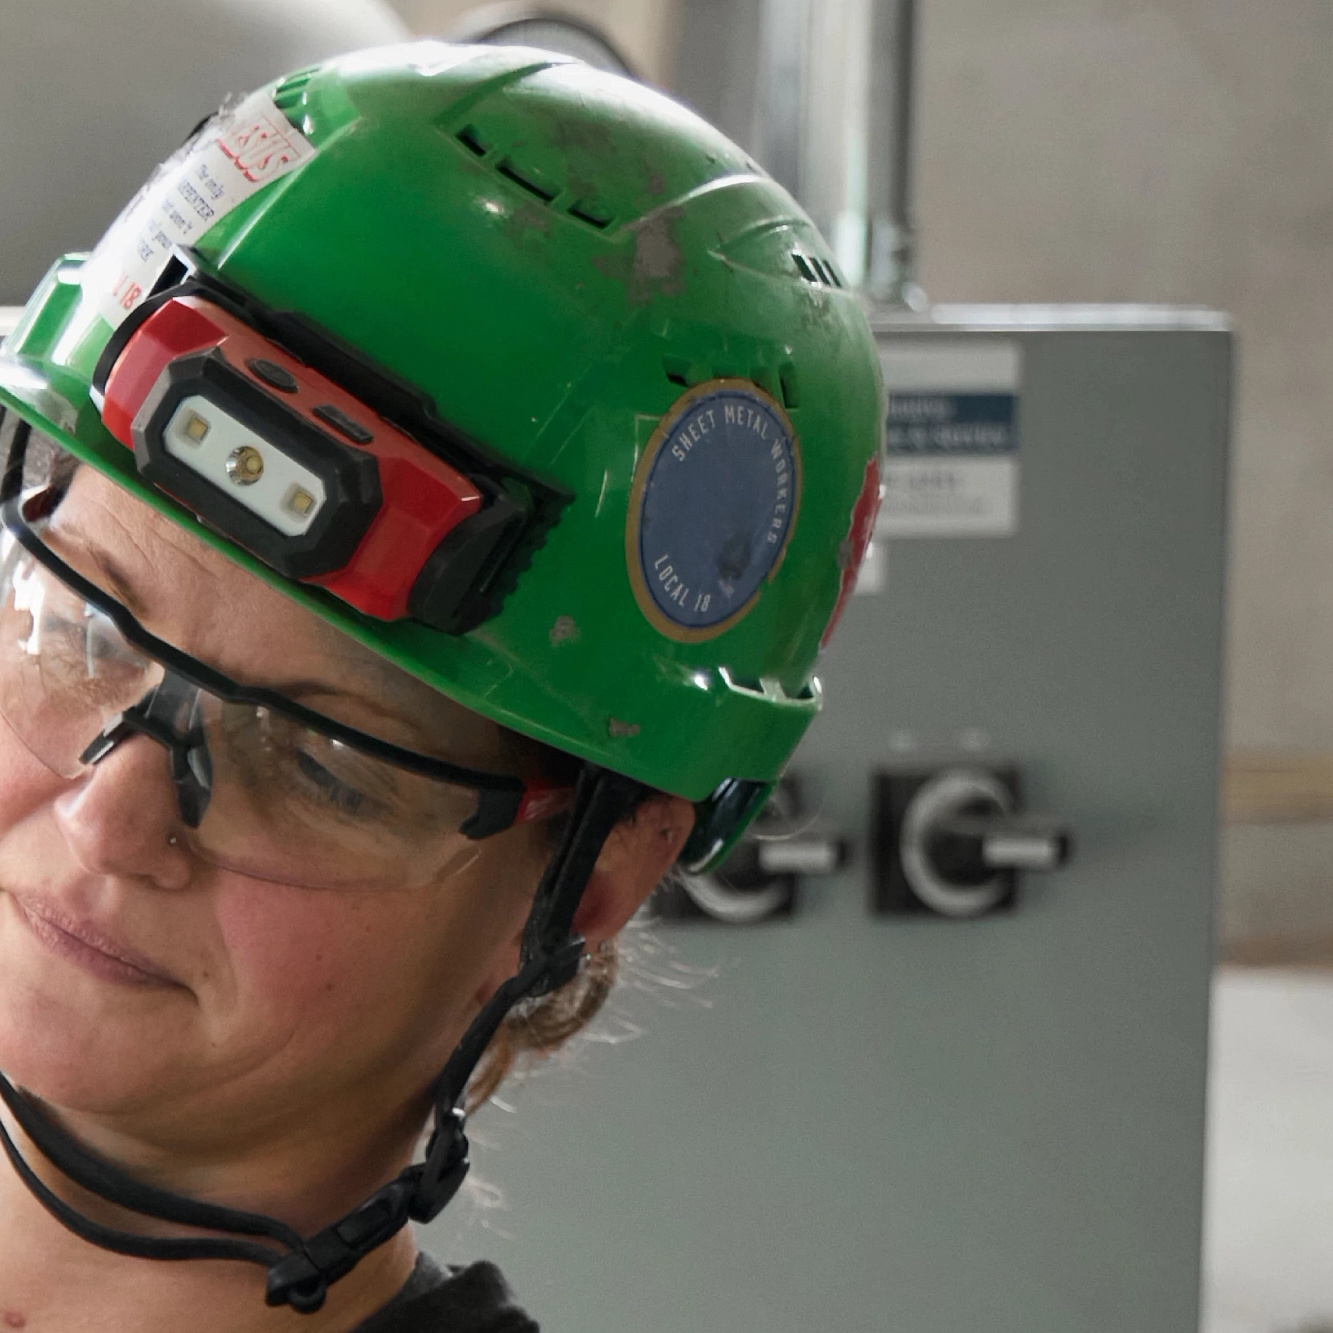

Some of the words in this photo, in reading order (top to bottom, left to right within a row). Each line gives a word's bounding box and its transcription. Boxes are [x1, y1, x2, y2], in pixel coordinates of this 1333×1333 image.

[119, 281, 142, 309] 18
[672, 409, 716, 462] SHEET
[724, 404, 769, 440] METAL
[767, 438, 789, 544] WORKERS
[654, 554, 690, 607] LOCAL
[694, 593, 711, 612] 18
